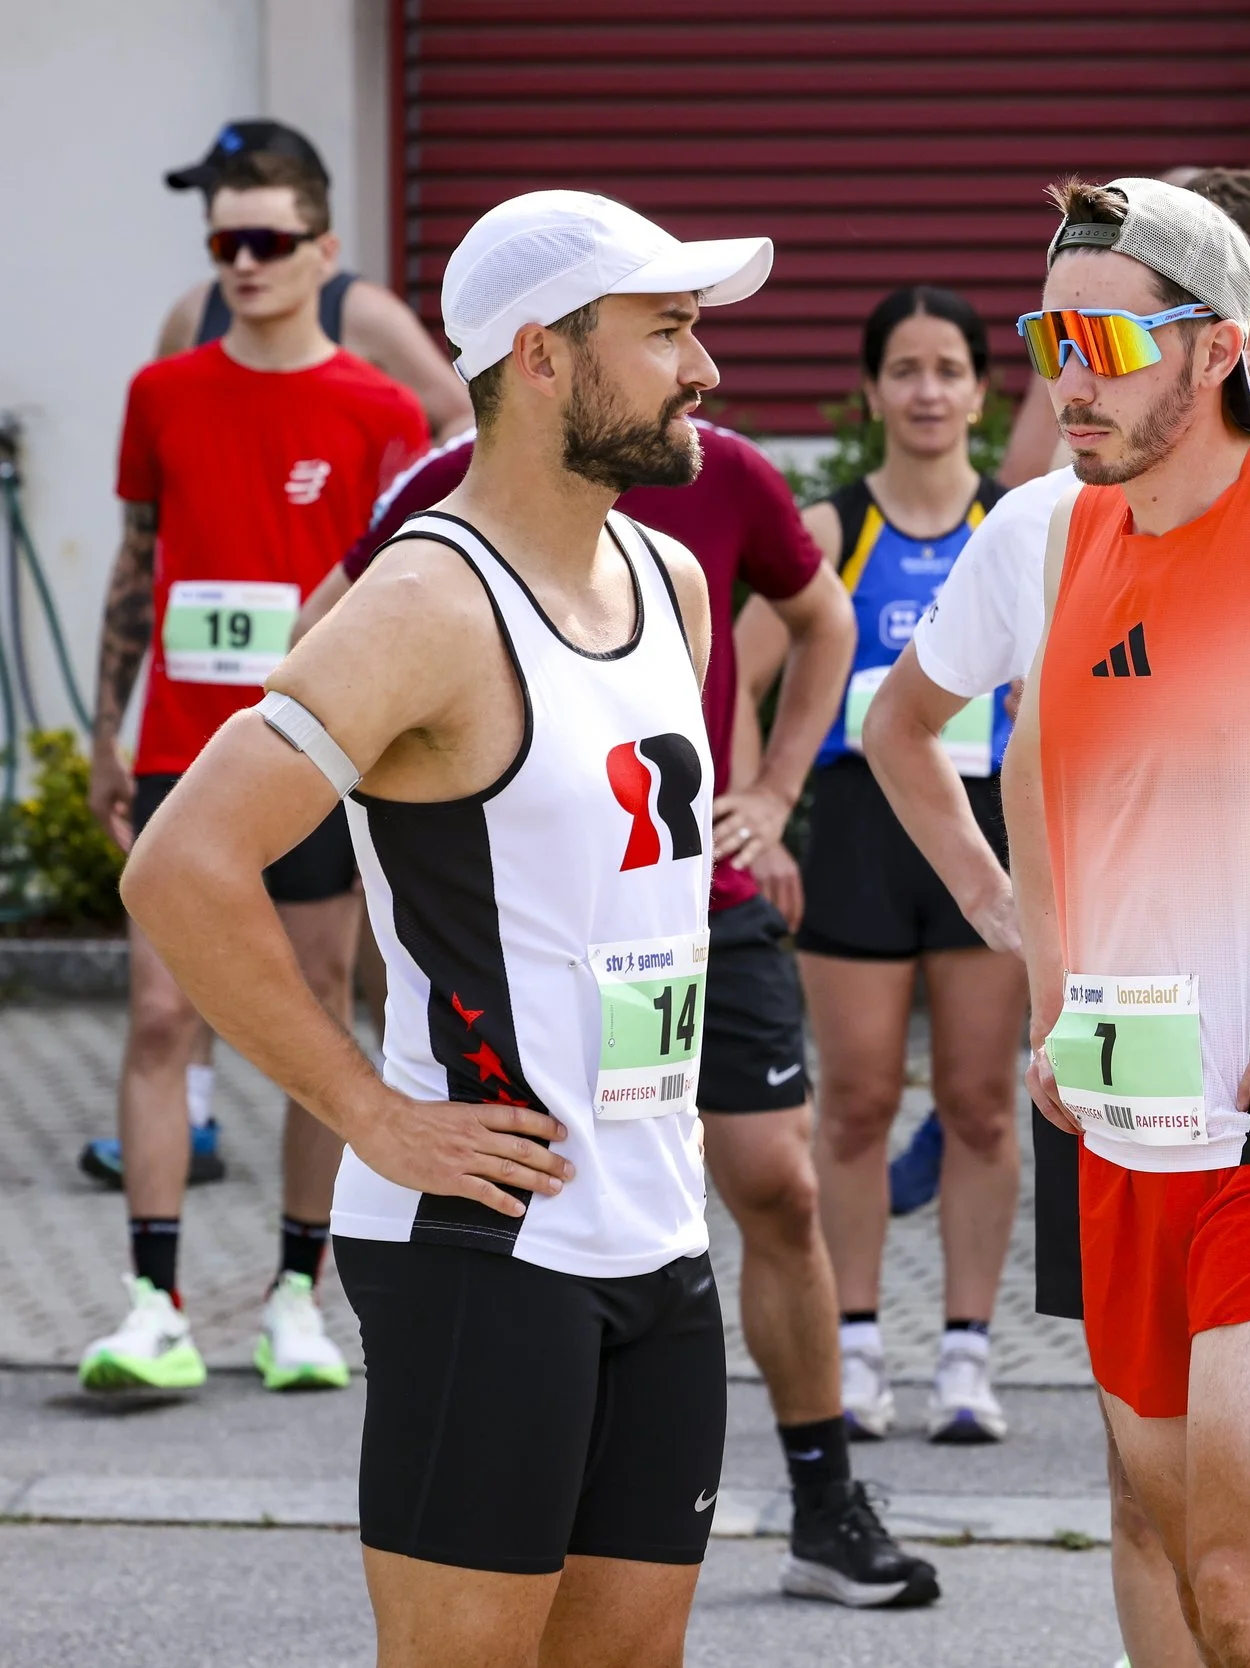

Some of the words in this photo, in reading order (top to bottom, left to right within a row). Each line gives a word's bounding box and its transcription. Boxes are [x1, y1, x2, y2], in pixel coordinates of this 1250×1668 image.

[205, 610, 252, 650] 19
[606, 953, 623, 972] stv
[638, 949, 673, 971] gampel
[1085, 986, 1103, 1004] gampel
[1117, 984, 1178, 1004] lonzalauf
[654, 983, 697, 1056] 14
[1094, 1022, 1116, 1086] 1
[601, 1086, 656, 1102] RAIFFEISEN
[1136, 1115, 1199, 1128] RAIFFEISEN
